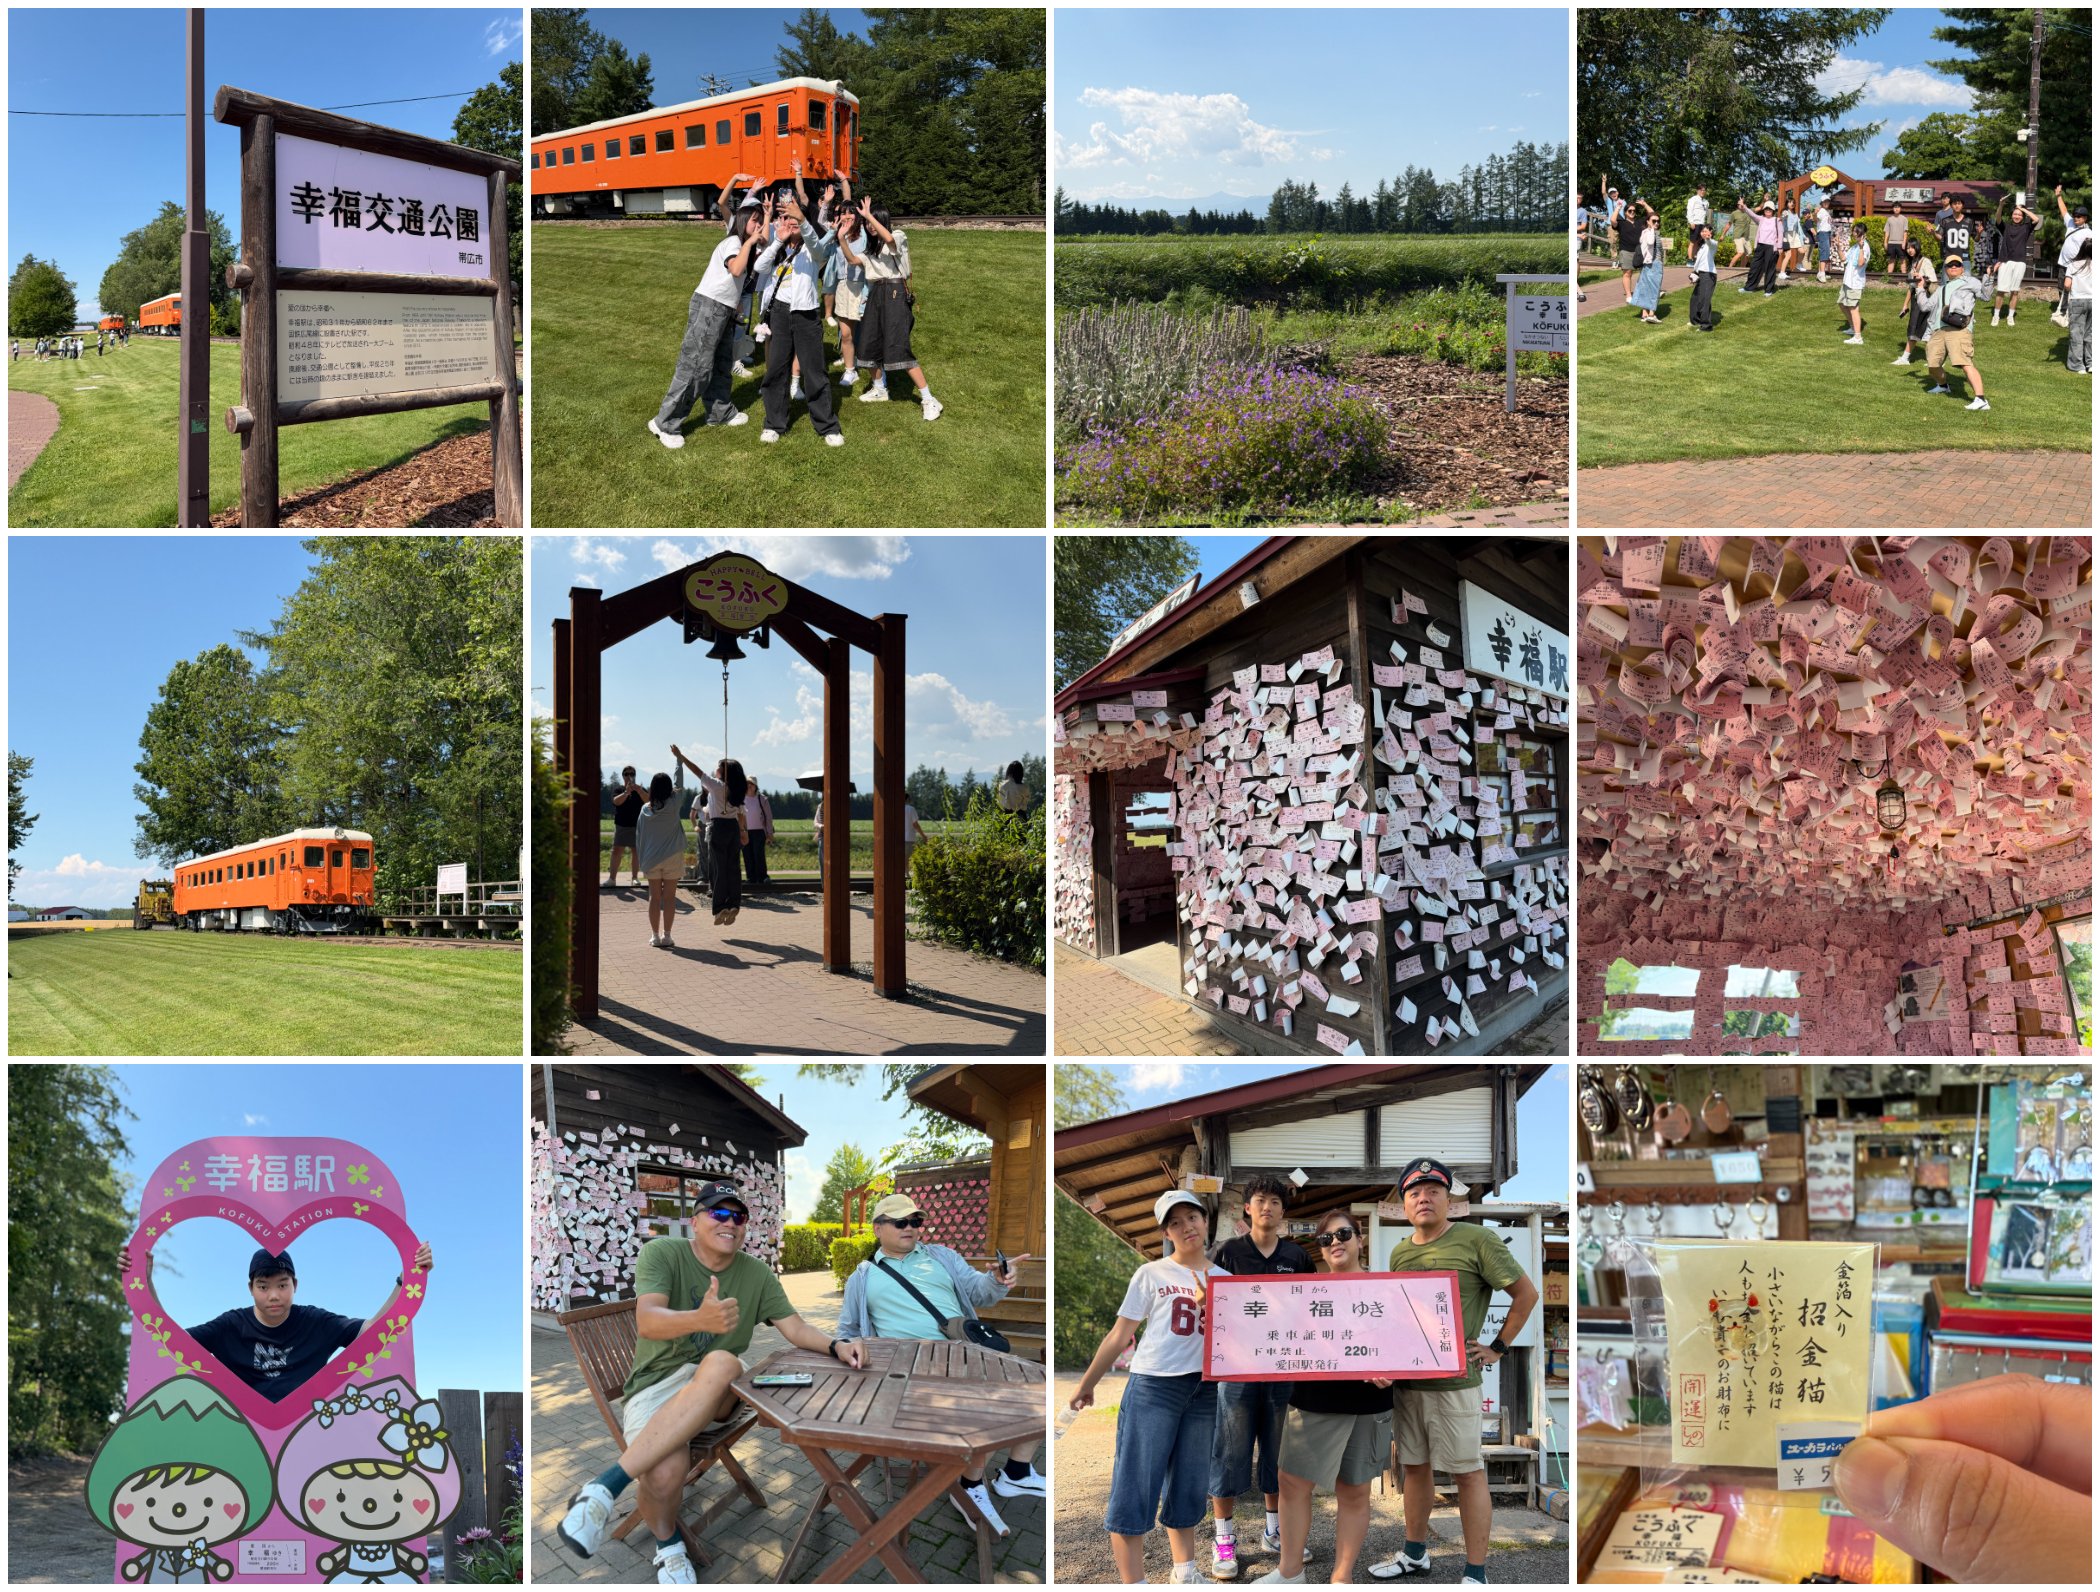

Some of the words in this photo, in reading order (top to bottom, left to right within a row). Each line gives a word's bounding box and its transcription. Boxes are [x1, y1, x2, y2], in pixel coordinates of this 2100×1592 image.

[1889, 188, 1932, 200] 幸福駅
[290, 181, 479, 243] 幸福交通公園
[1947, 228, 1969, 249] 09
[458, 251, 483, 266] 帯広市
[1525, 301, 1567, 311] こうふ
[710, 566, 738, 577] HAPPY
[695, 579, 778, 607] こうふく
[1487, 617, 1569, 692] 幸福駅
[204, 1153, 336, 1193] 幸福駅
[219, 1207, 271, 1239] KOFUKU
[277, 1208, 334, 1239] STATION
[1251, 1285, 1262, 1294] 愛
[1291, 1285, 1303, 1294] 国
[1834, 1260, 1854, 1338] 金箔入り
[1243, 1300, 1269, 1318] 幸
[1309, 1300, 1334, 1317] 福
[1352, 1301, 1385, 1318] ゆき
[1267, 1329, 1354, 1341] 乗車証明書
[1768, 1267, 1786, 1410] 小さいながらこの猫は
[1254, 1347, 1306, 1356] 下車禁止
[1344, 1345, 1379, 1357] 220円
[1795, 1298, 1828, 1404] 招金猫
[1275, 1358, 1339, 1371] 愛国駅発行
[1412, 1357, 1423, 1366] 小
[1632, 1519, 1697, 1534] こうふく
